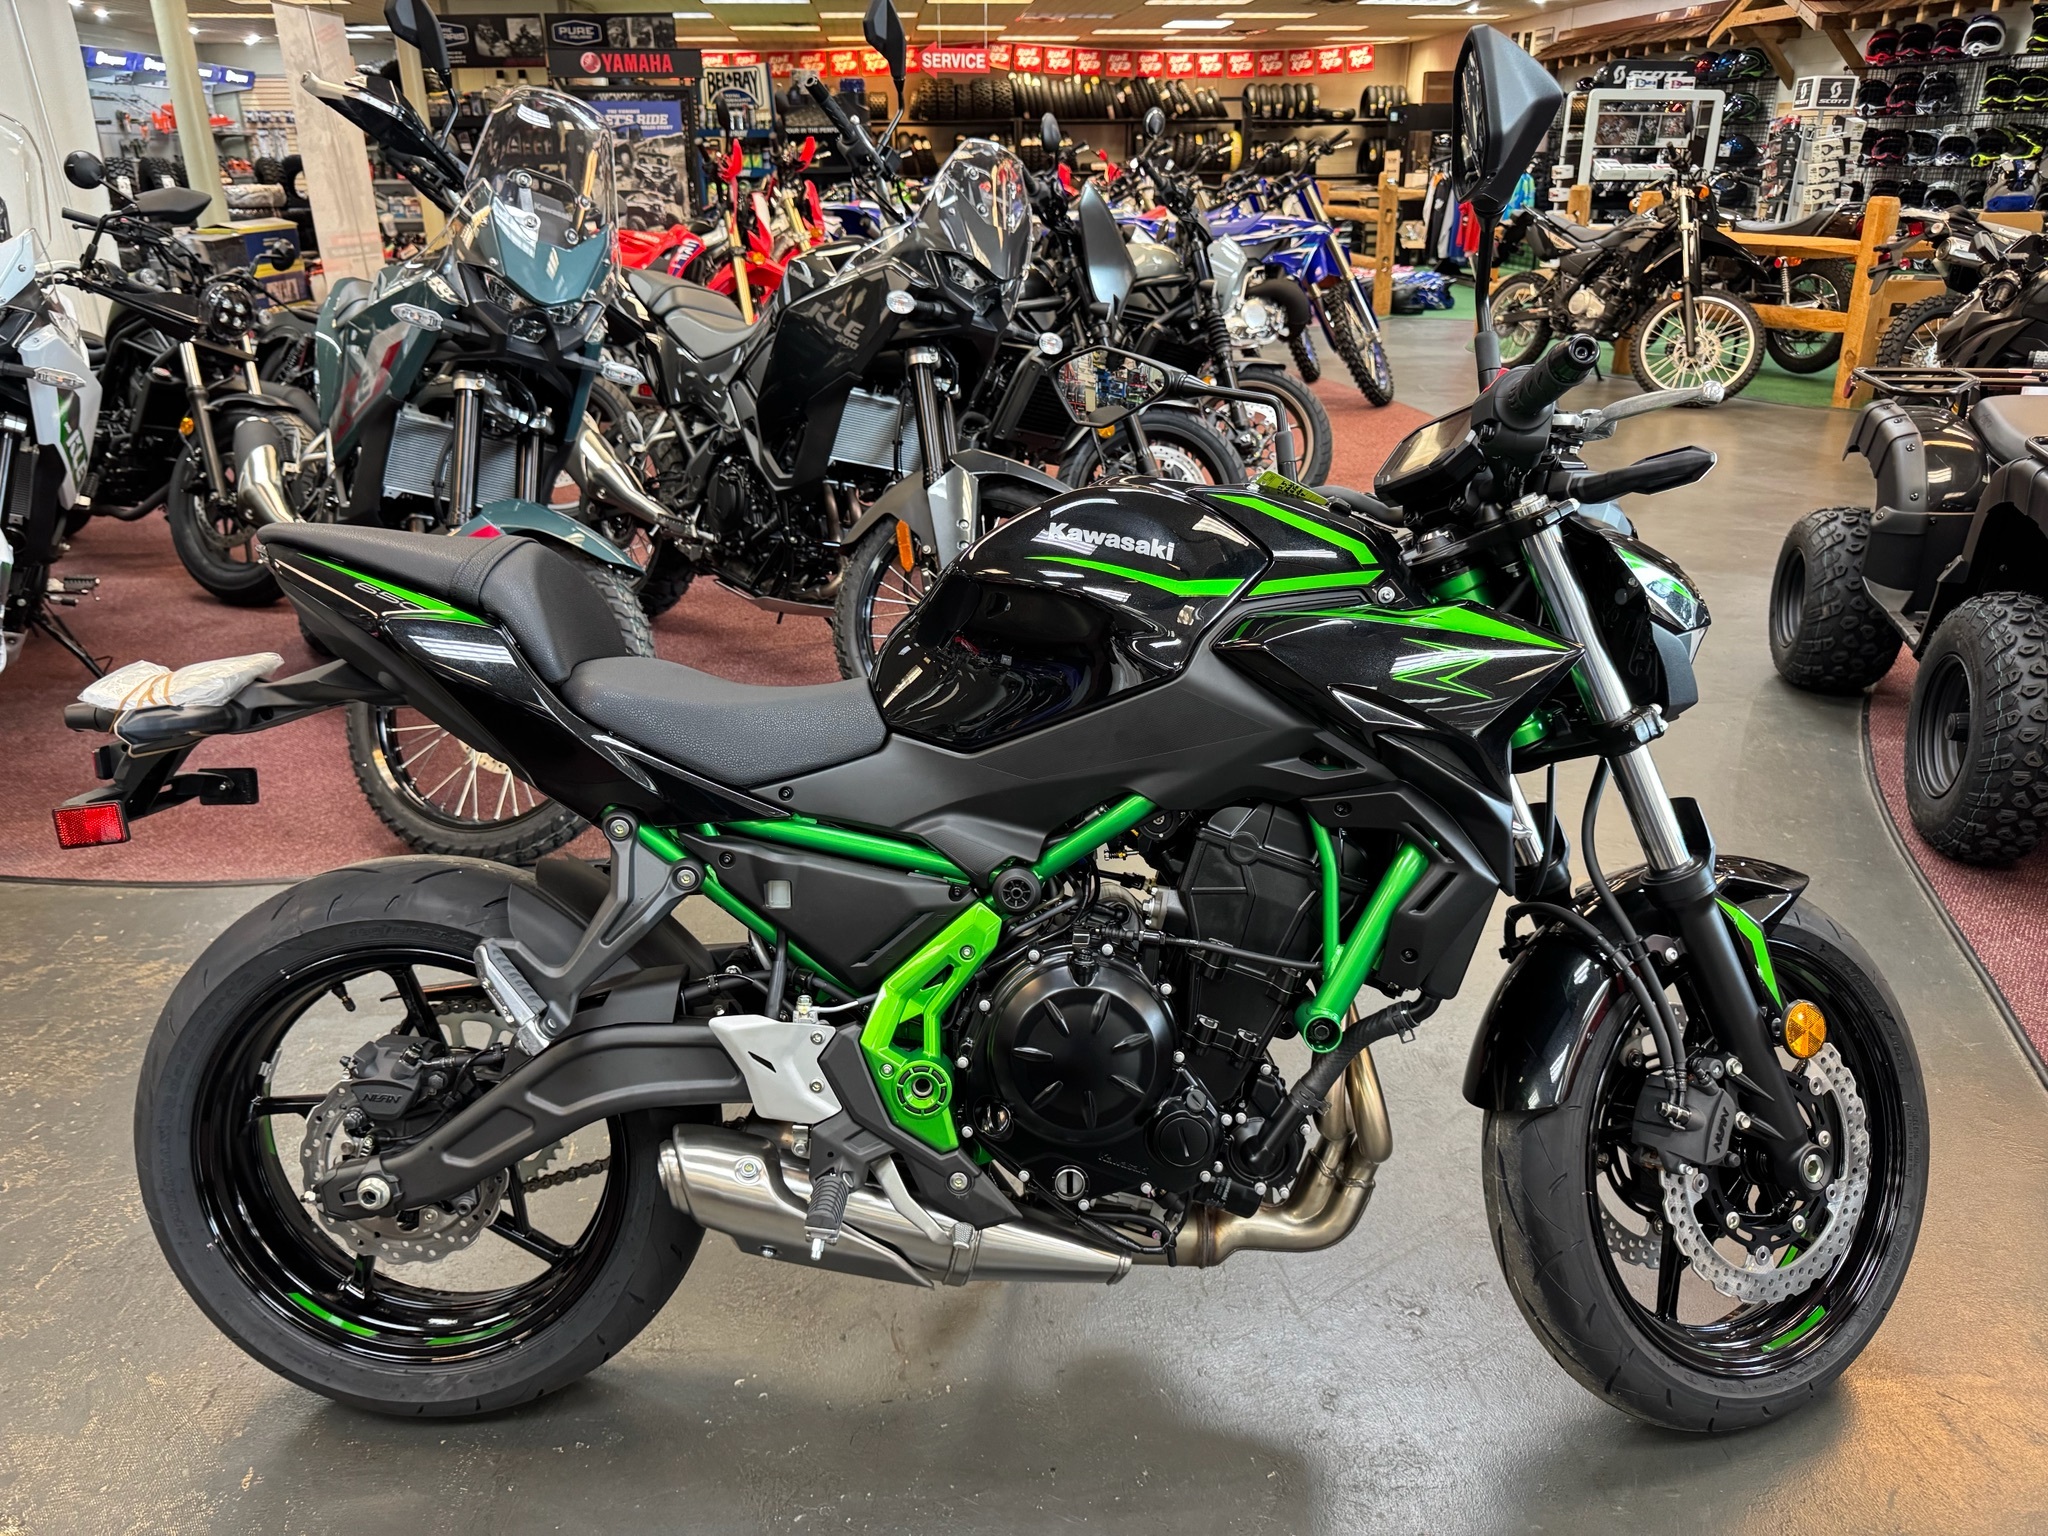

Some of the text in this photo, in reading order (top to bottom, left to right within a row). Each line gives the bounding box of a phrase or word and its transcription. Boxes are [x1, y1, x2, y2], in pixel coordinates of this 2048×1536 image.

[558, 26, 595, 35] PURE
[601, 53, 674, 73] YAMAHA
[922, 53, 986, 68] SERVICE
[1628, 70, 1688, 80] SCOTT
[636, 114, 669, 125] RIDE
[835, 333, 860, 350] 500
[1048, 522, 1176, 562] Kawasaki
[354, 582, 425, 611] 650
